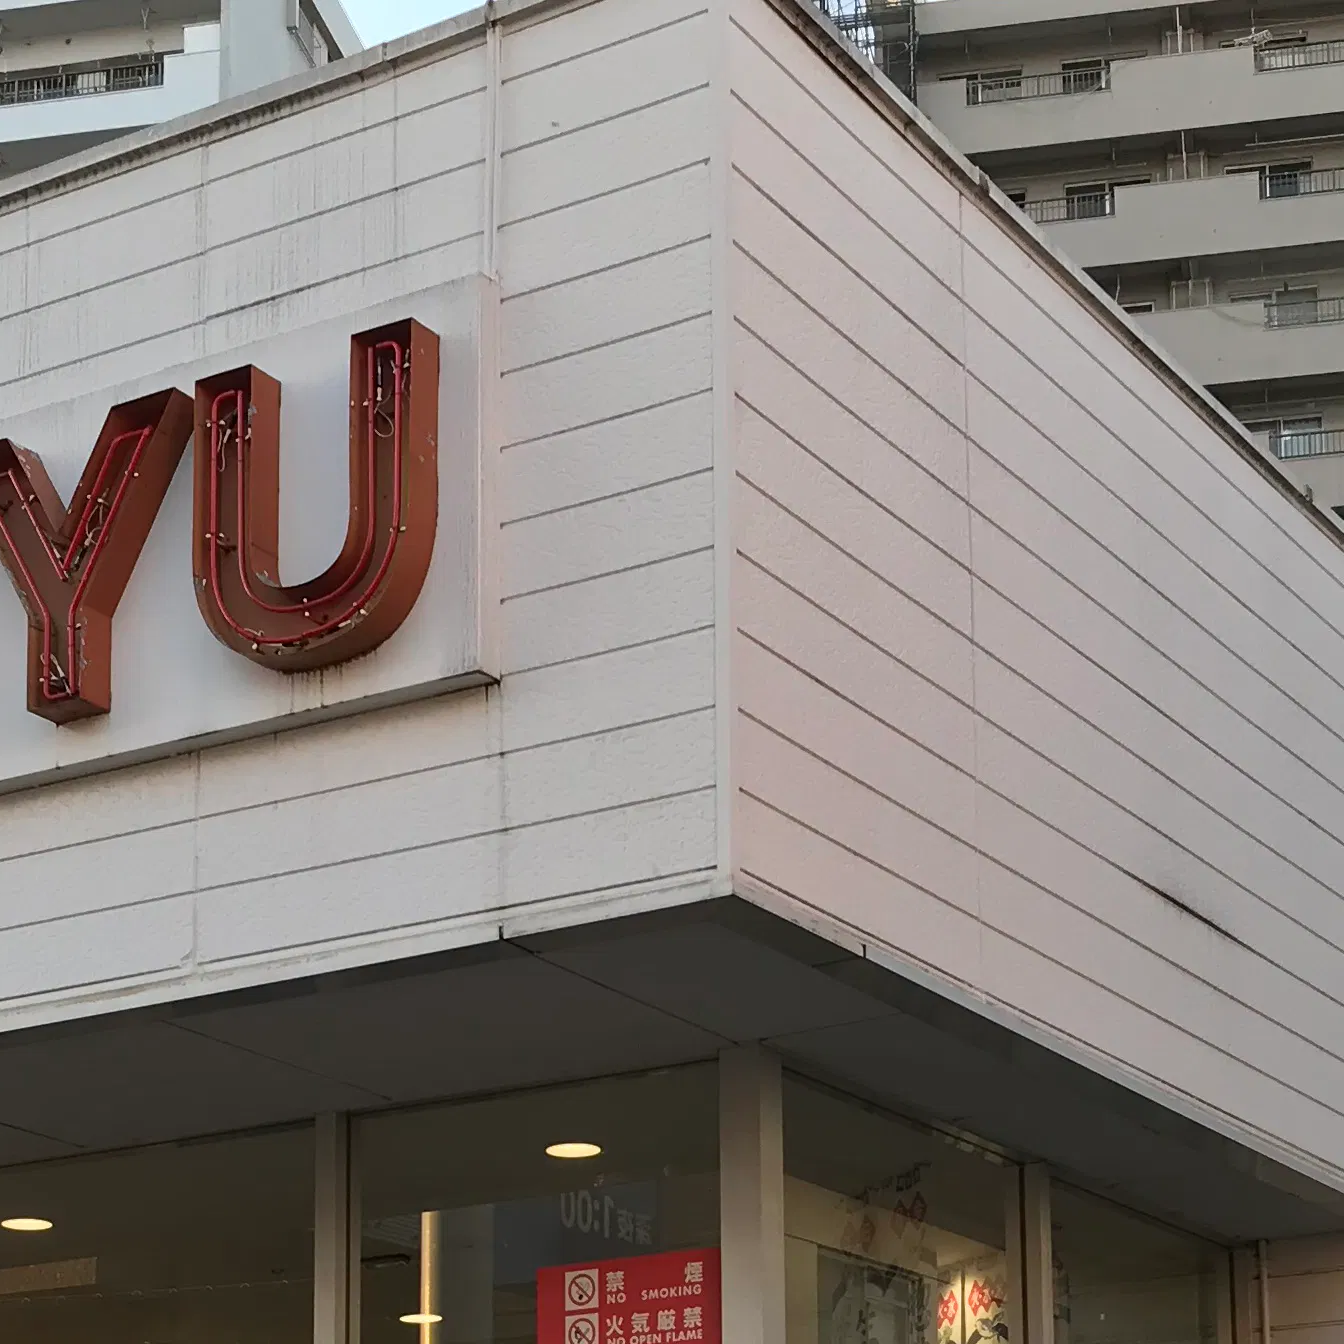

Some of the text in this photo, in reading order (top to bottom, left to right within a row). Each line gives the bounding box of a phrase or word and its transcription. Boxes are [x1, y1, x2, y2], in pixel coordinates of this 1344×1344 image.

[606, 1284, 702, 1304] NO SMOKING
[666, 1329, 703, 1343] FLAME
